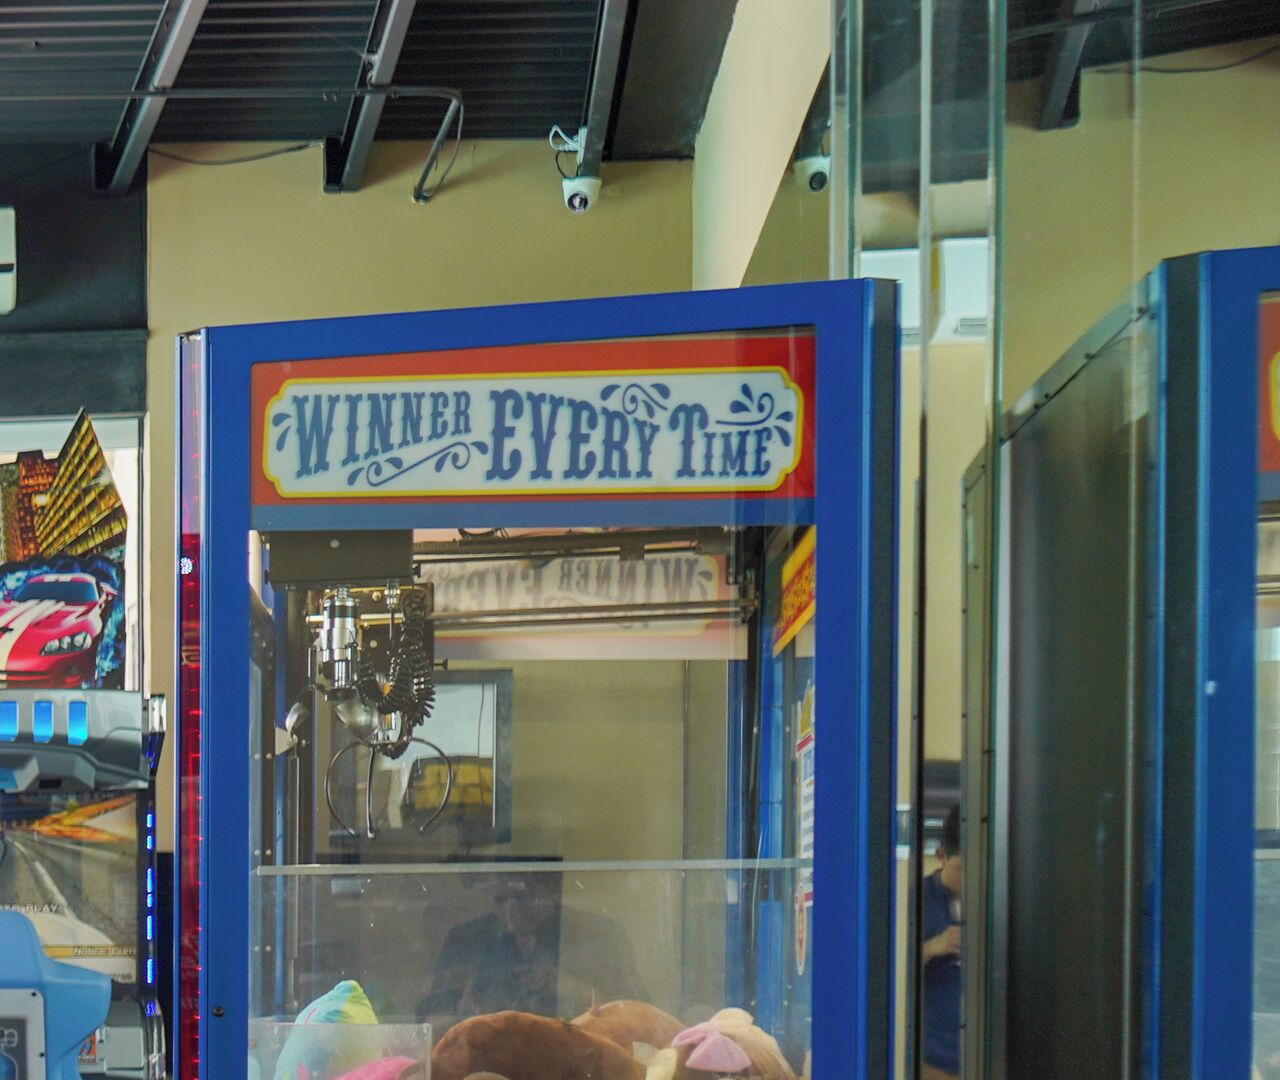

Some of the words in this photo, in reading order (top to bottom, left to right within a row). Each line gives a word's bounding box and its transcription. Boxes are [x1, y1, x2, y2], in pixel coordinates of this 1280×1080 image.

[290, 389, 474, 480] WINNER
[484, 387, 662, 483] EVERY
[669, 402, 775, 479] TIME
